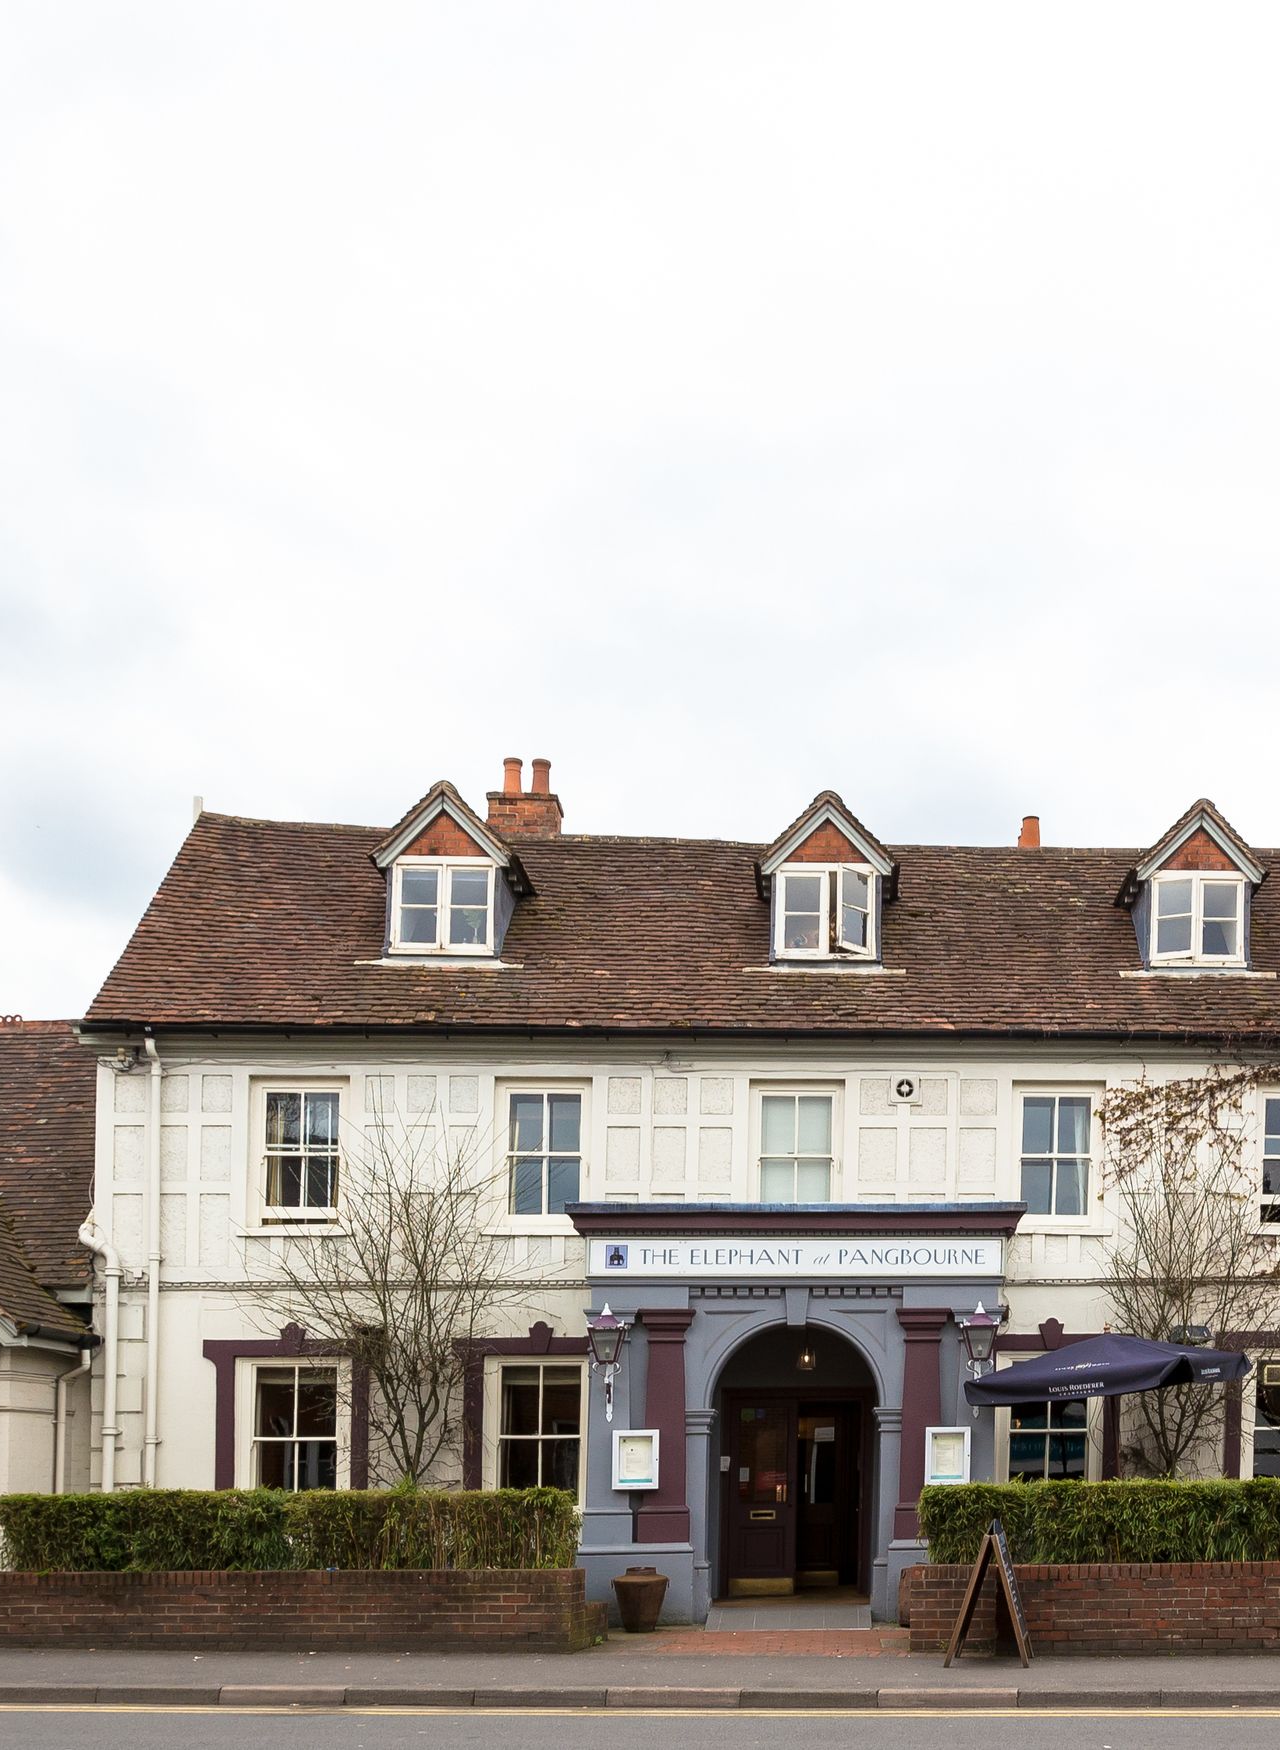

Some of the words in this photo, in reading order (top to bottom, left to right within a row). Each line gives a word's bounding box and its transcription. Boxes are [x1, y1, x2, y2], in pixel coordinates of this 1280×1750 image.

[639, 1248, 680, 1265] THE
[690, 1248, 804, 1265] ELEPHANT
[812, 1253, 831, 1265] at
[838, 1248, 986, 1266] PANGBOURNE
[1069, 1381, 1105, 1391] ROEDERER
